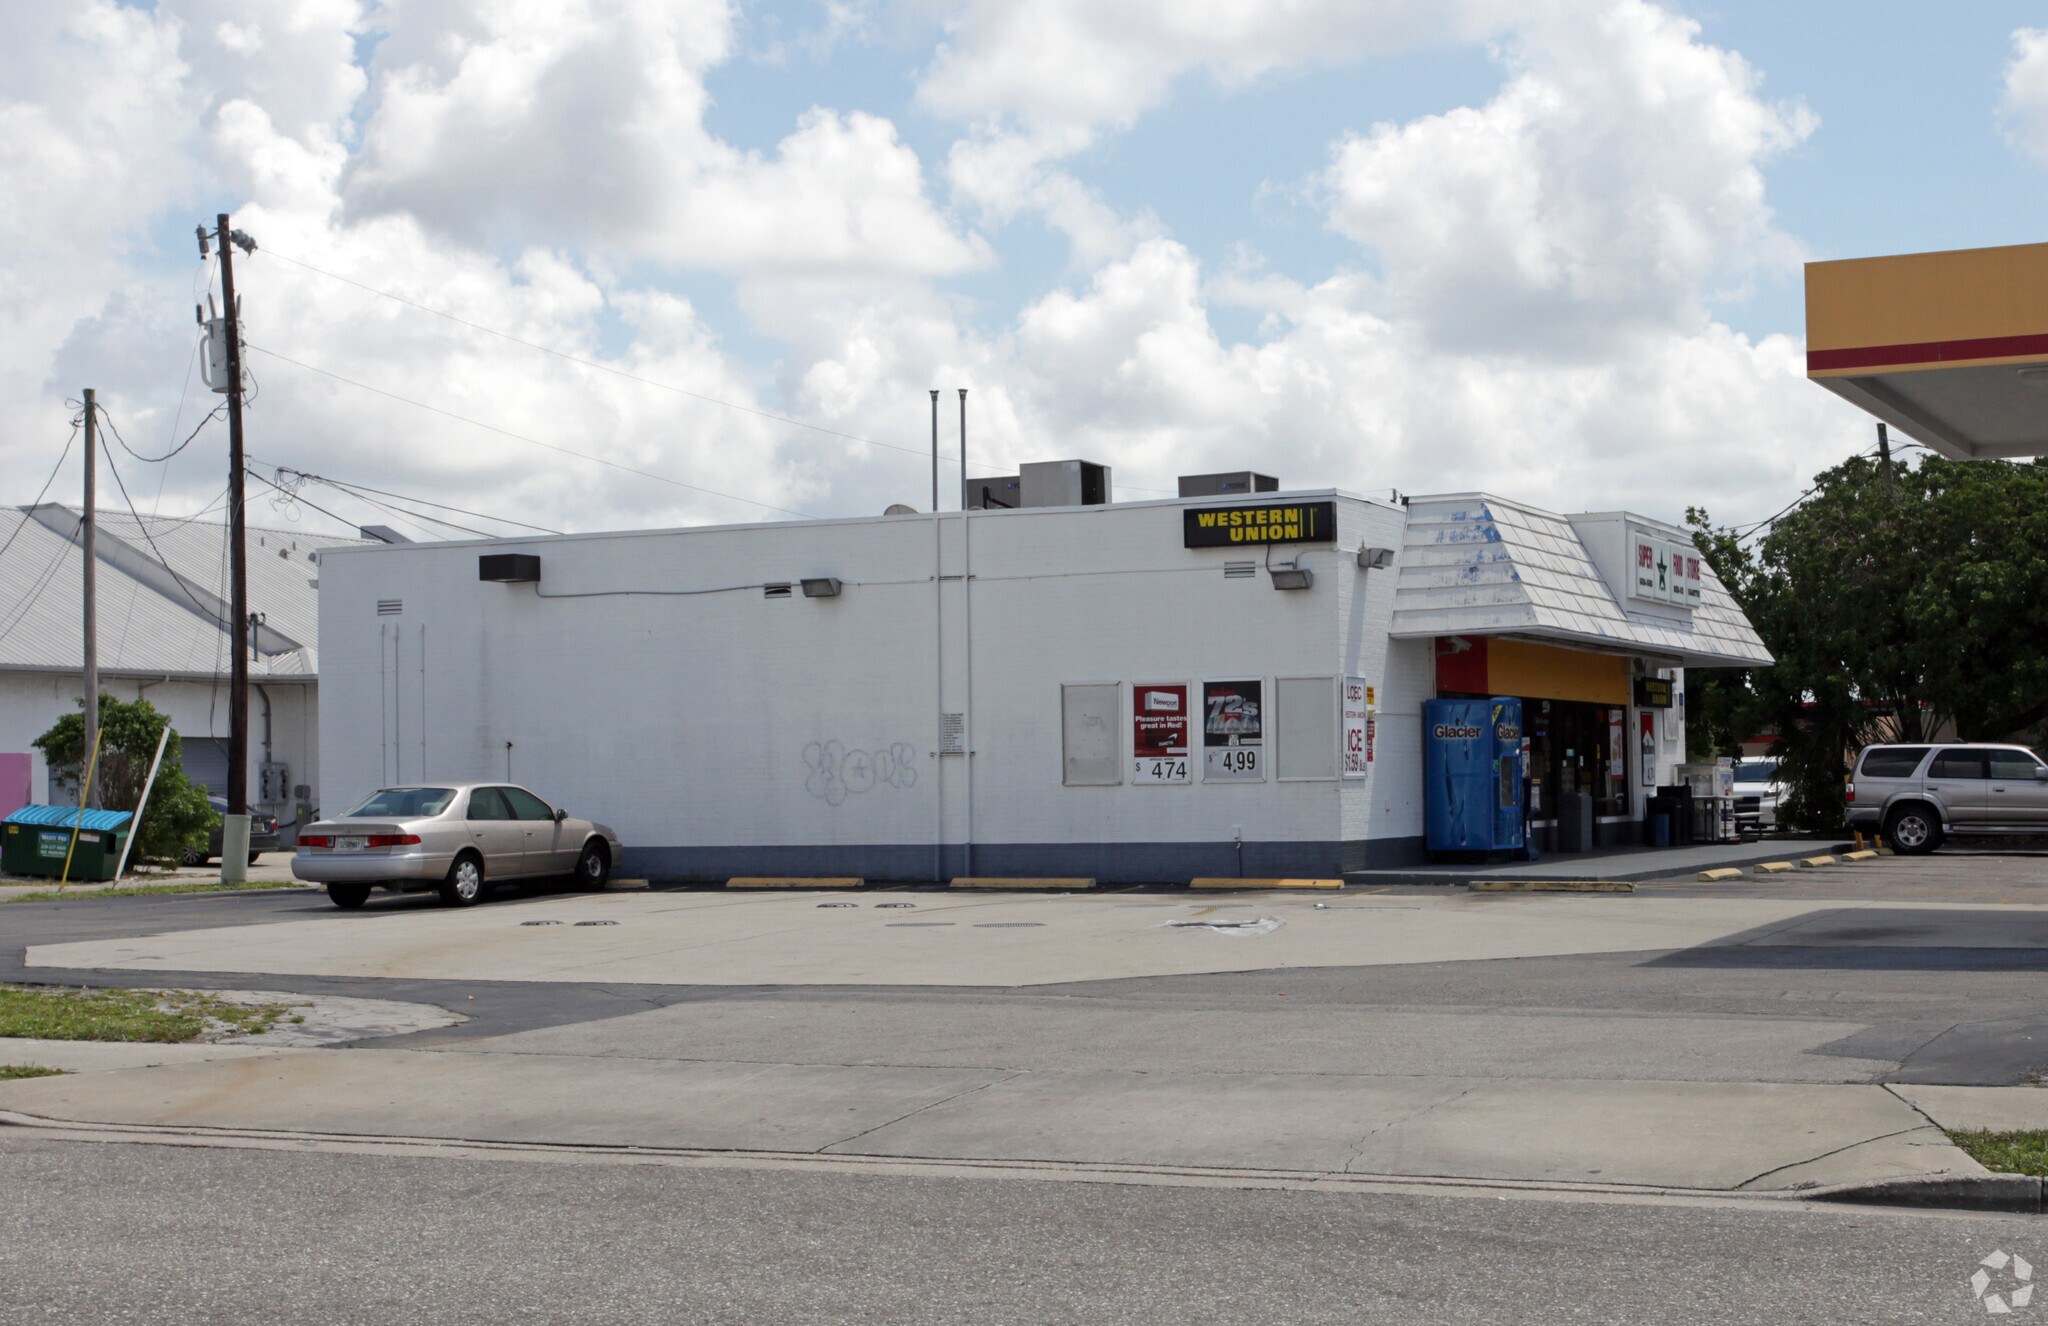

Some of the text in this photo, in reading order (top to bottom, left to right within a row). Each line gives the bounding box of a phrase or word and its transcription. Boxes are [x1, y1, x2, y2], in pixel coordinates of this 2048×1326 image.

[1198, 508, 1298, 528] WESTERN
[1230, 524, 1299, 542] UNION
[1639, 544, 1700, 580] SUPER FOOD STORE
[1153, 697, 1178, 706] Newport
[1208, 695, 1258, 717] 72's
[1140, 722, 1158, 730] great
[1434, 725, 1482, 738] Glacier
[1497, 724, 1519, 739] Glacier
[1347, 728, 1362, 752] ICE
[1135, 761, 1187, 780] $ 4.74
[1223, 751, 1256, 774] 4.99
